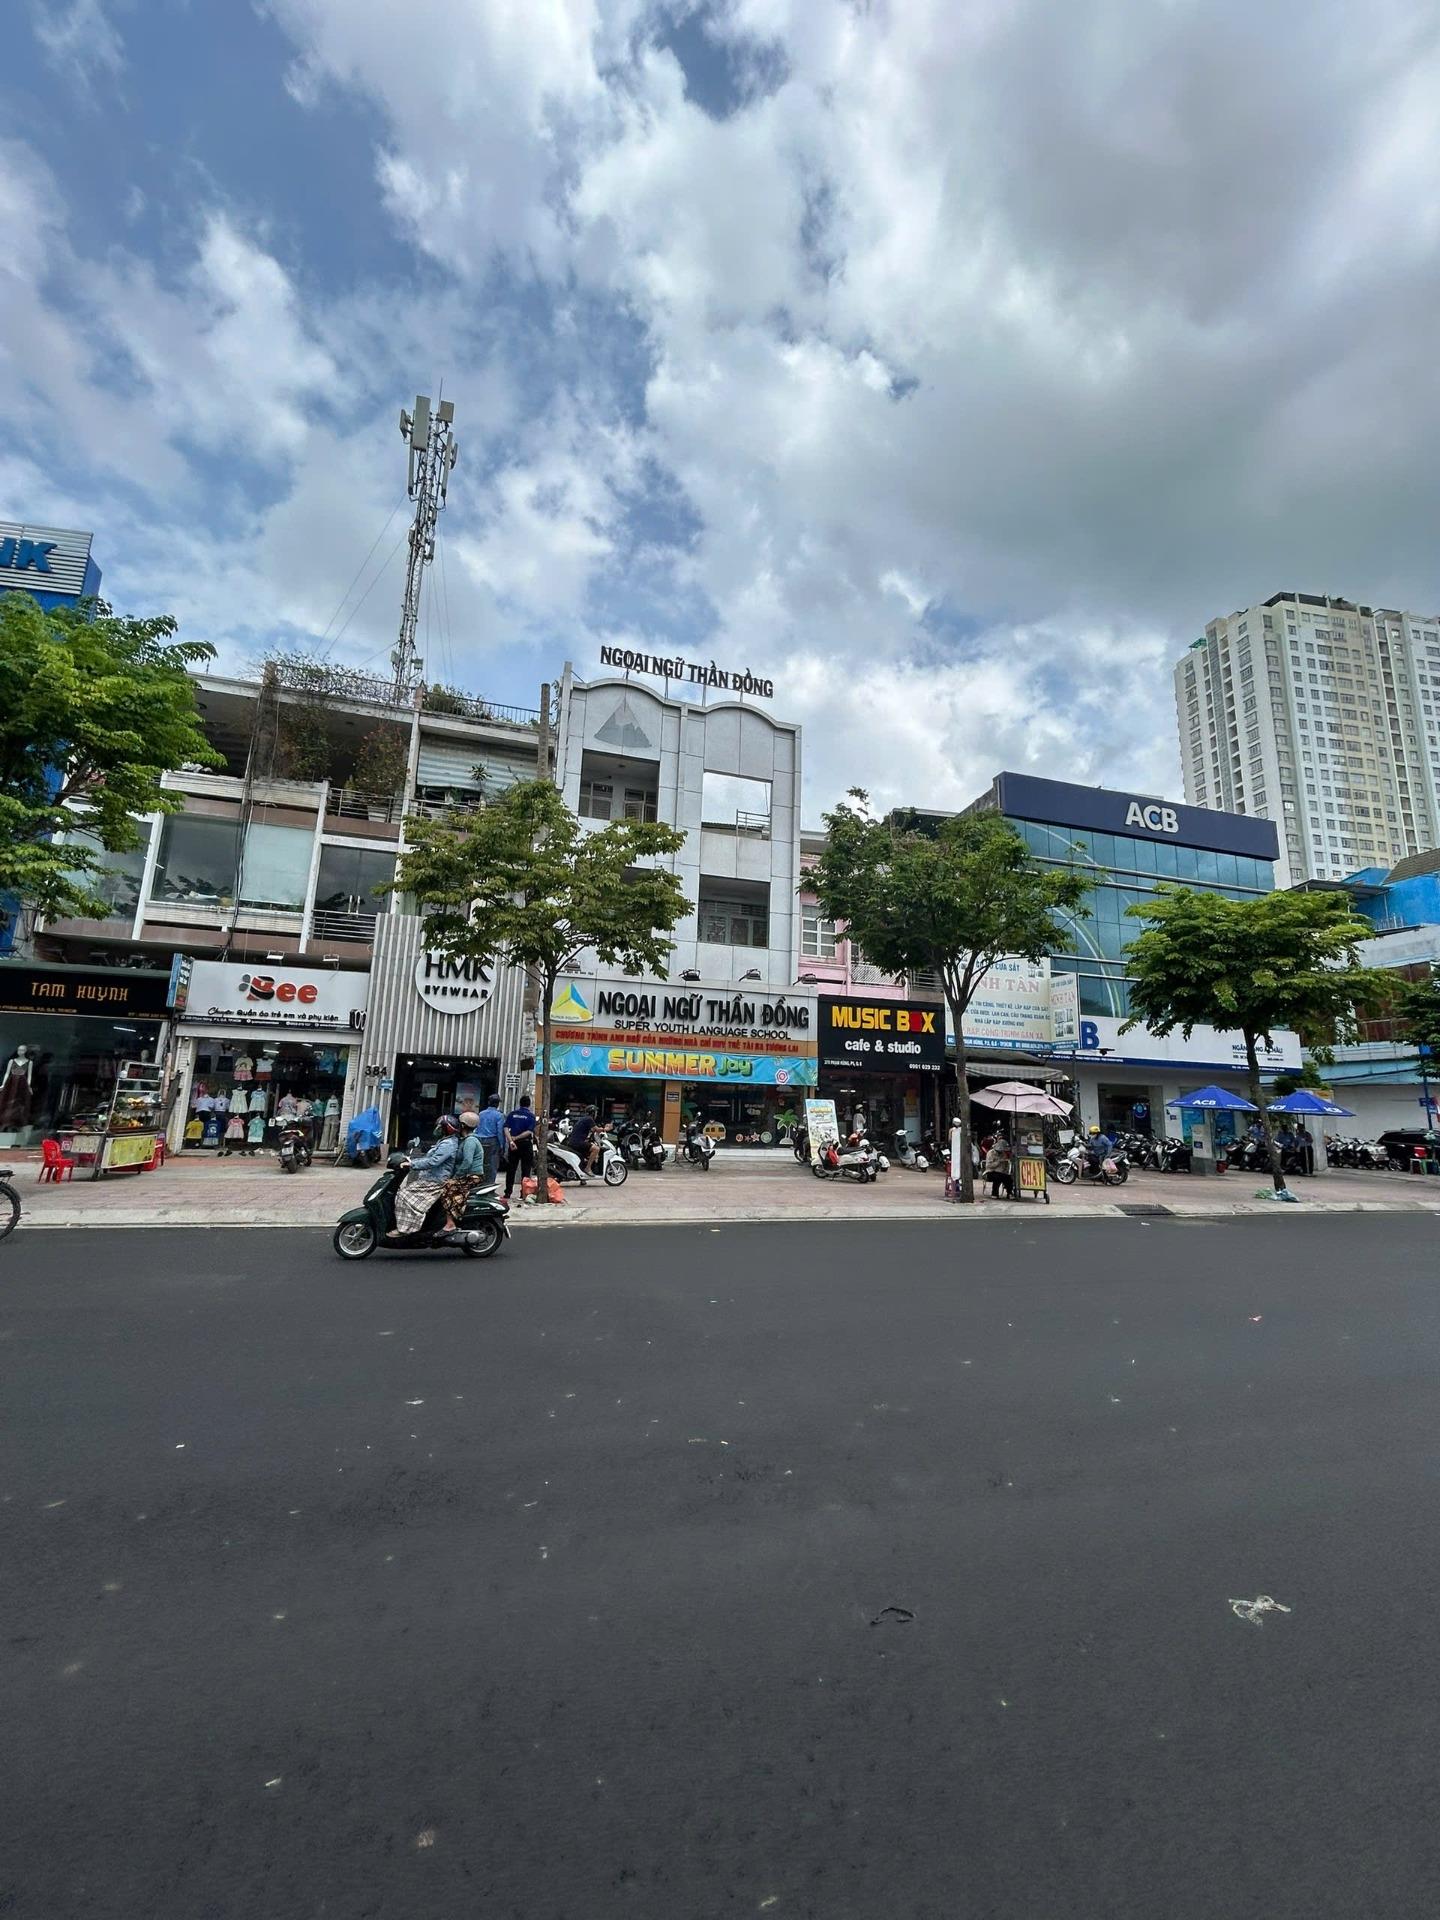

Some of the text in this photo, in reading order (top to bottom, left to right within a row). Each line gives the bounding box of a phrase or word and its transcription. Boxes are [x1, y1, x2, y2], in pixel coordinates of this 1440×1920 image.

[600, 645, 650, 674] NGOẠI
[651, 656, 685, 680] NGỮ
[1125, 801, 1179, 833] ACB
[425, 952, 491, 982] HMK
[247, 975, 318, 1004] Bee
[424, 985, 489, 999] EYEWEAR
[598, 991, 809, 1029] NGOẠI NGỮ THẦN ĐỒNG
[832, 1005, 892, 1030] MUSIC
[614, 1020, 791, 1040] SUPER YOUTH LANGUAGE SCHOOL
[844, 1038, 922, 1055] cafe & studio
[364, 1065, 387, 1077] 384
[608, 1047, 717, 1076] SUMMER
